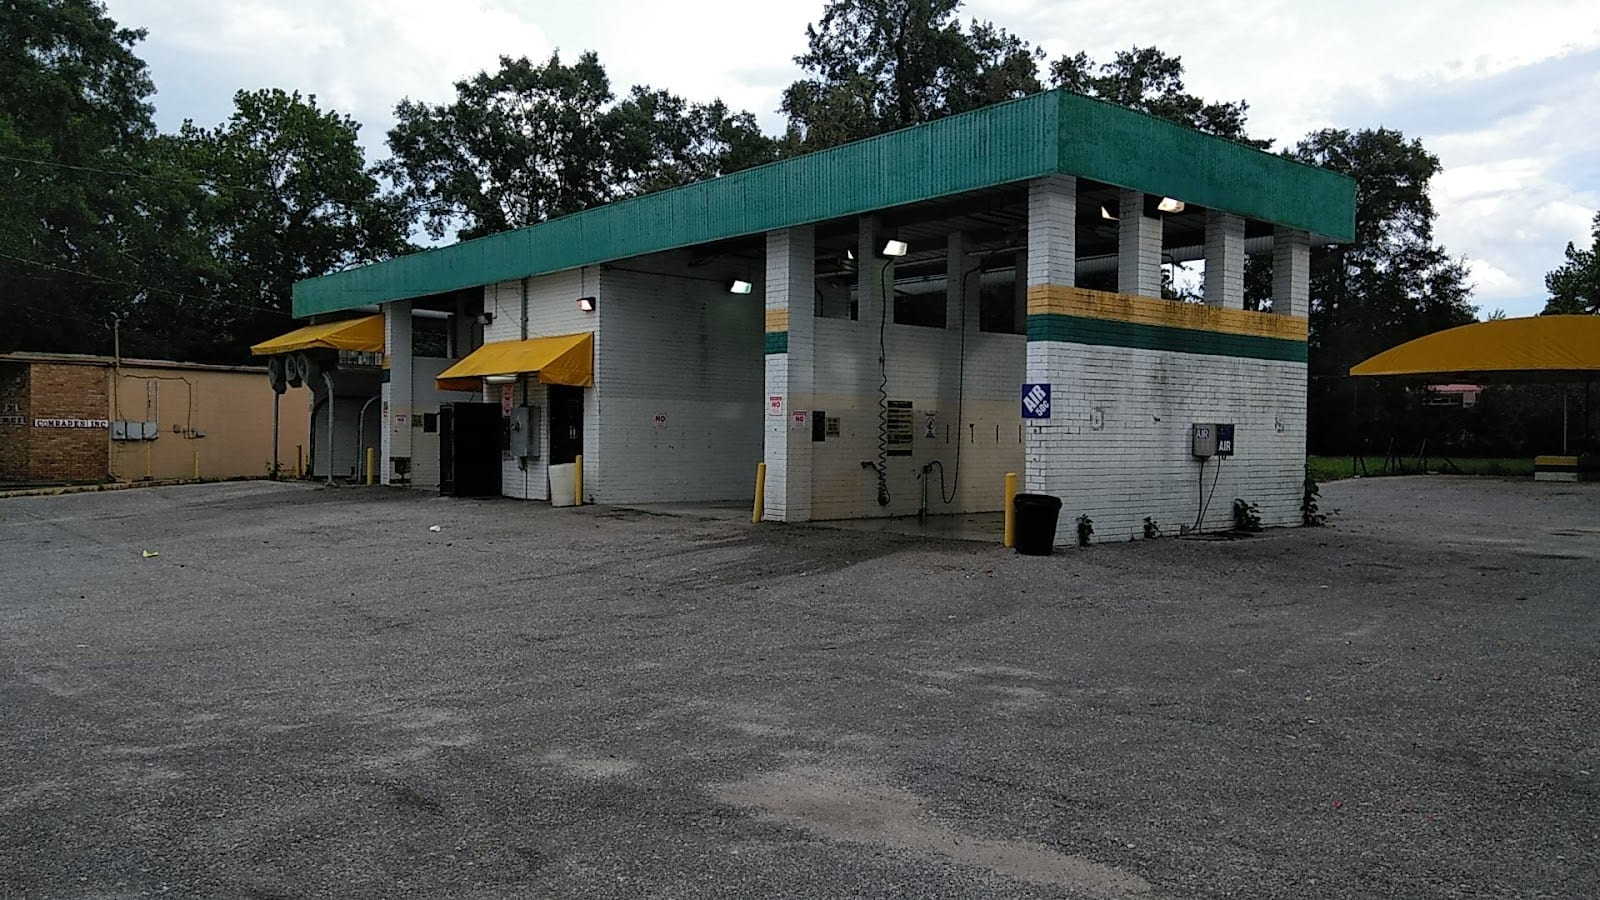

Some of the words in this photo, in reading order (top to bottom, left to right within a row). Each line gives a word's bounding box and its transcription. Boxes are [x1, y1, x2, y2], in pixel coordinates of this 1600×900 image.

[1023, 385, 1047, 413] AIR
[91, 420, 107, 428] INC
[1195, 429, 1210, 439] AIR
[1218, 440, 1231, 451] AIR
